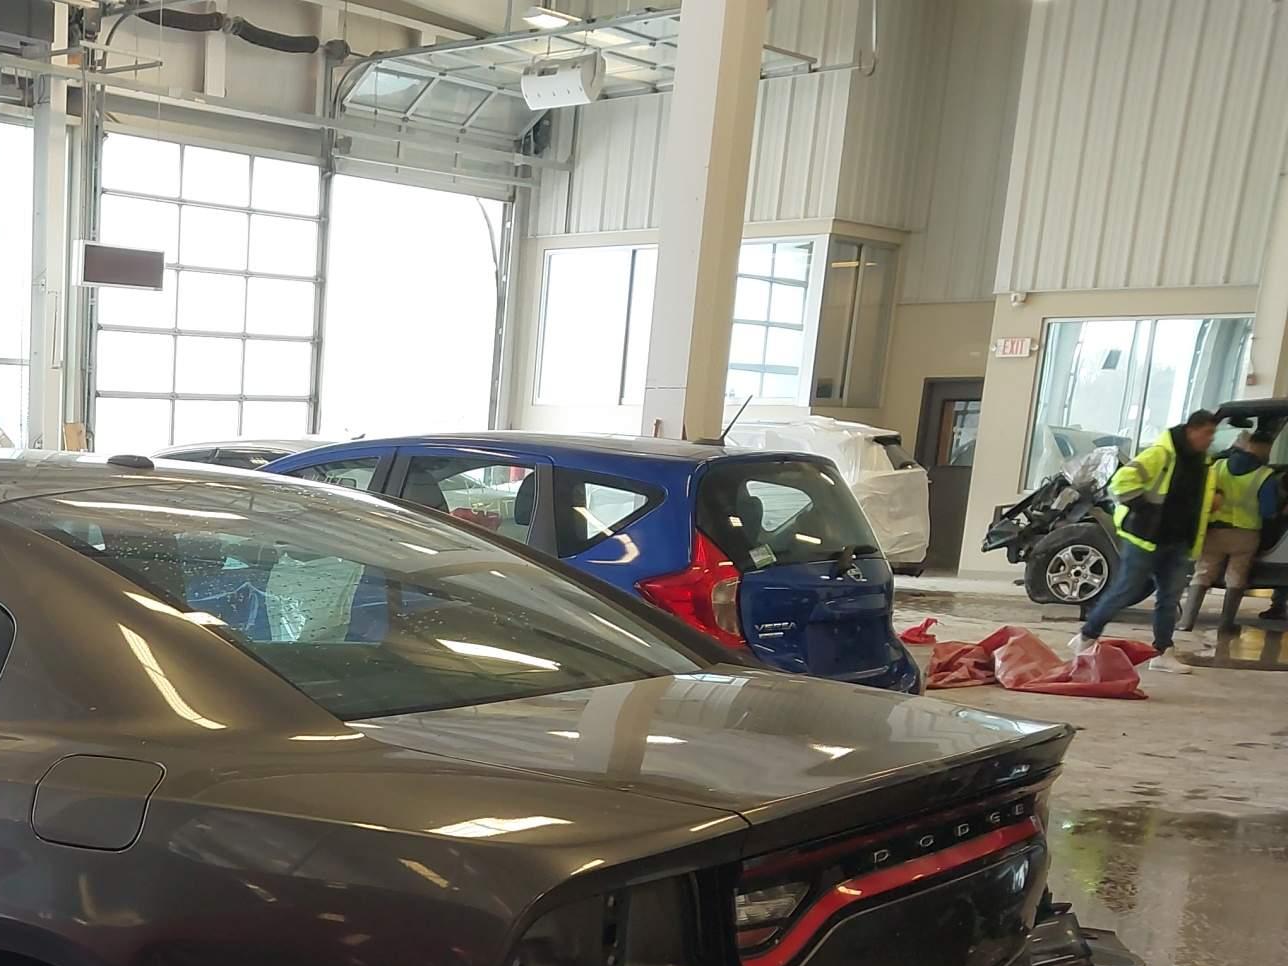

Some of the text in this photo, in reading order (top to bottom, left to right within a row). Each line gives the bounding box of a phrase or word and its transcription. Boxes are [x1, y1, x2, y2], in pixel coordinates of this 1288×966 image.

[1002, 338, 1026, 355] EXIT
[754, 621, 798, 631] VERSA
[873, 803, 1025, 864] DODGE
